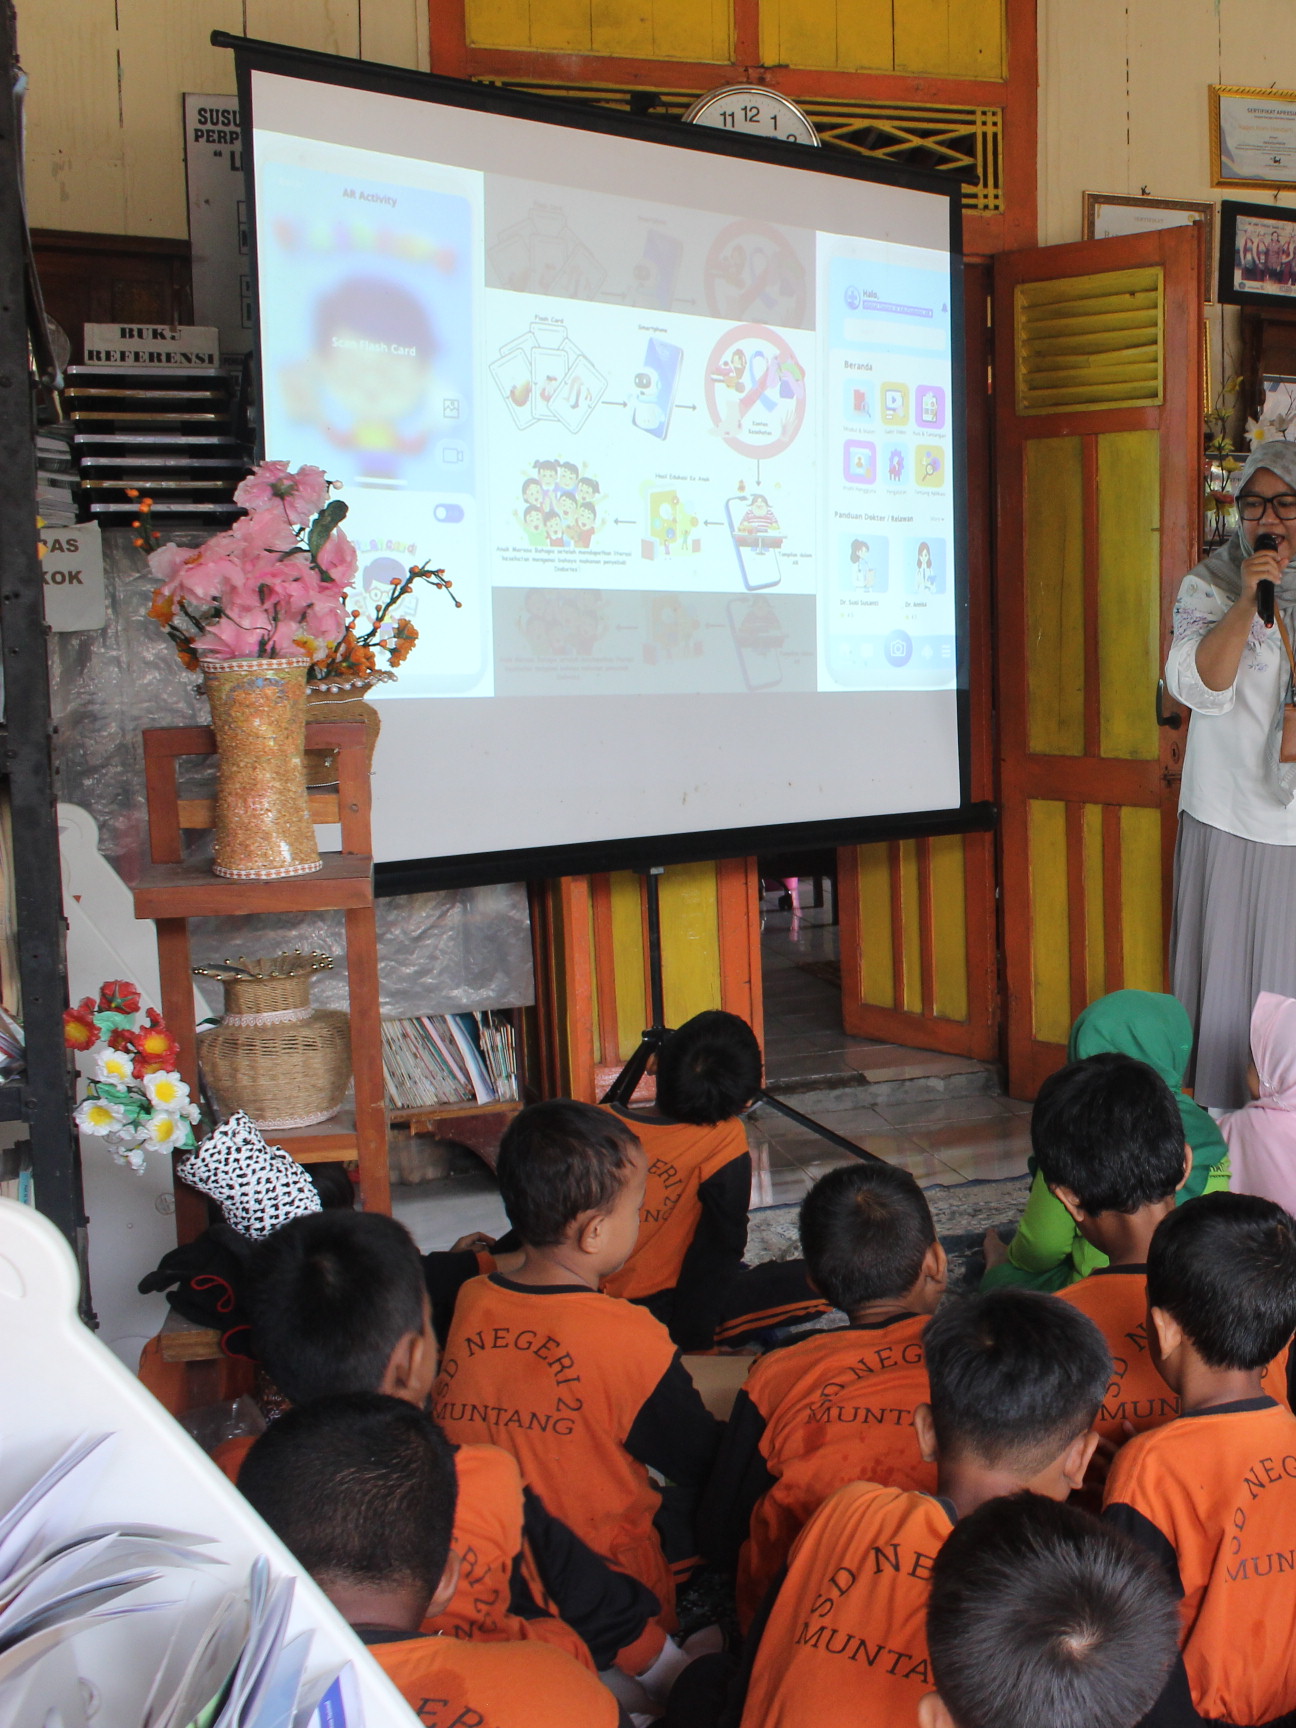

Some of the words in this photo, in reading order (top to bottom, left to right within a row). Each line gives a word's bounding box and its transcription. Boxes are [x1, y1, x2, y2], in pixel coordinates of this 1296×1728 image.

[720, 111, 735, 128] 11
[741, 105, 760, 123] 12
[770, 114, 777, 131] 1
[342, 188, 356, 199] AR
[358, 190, 397, 208] Activity
[87, 349, 215, 365] REFERENSI
[390, 344, 416, 357] Card
[843, 359, 873, 371] Beranda
[436, 1358, 459, 1399] SD
[464, 1327, 581, 1388] NEGERI
[555, 1397, 584, 1413] 2
[433, 1402, 576, 1436] MUNTANG
[809, 1565, 857, 1619] SD
[794, 1621, 935, 1686] MUNTA
